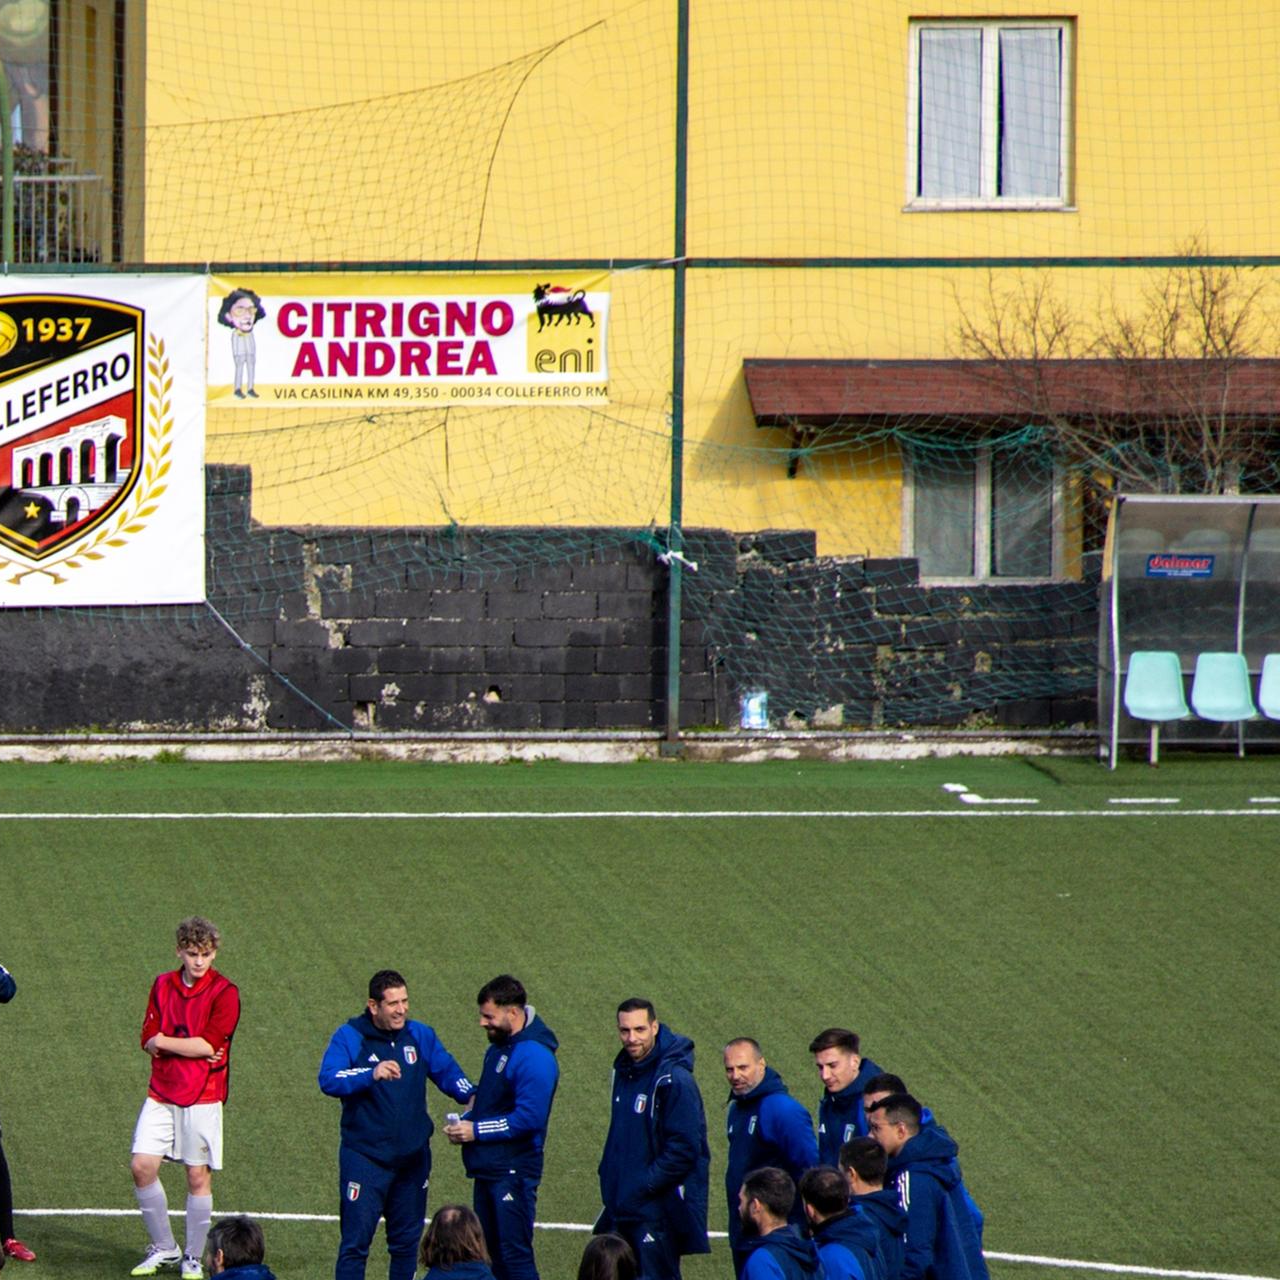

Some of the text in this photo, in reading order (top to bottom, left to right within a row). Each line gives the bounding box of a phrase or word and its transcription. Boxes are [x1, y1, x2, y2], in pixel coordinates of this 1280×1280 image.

[22, 317, 91, 343] 1937
[276, 300, 515, 338] CITRIGNO
[291, 341, 498, 377] ANDREA
[535, 338, 594, 374] eni
[274, 388, 298, 399] VIA
[301, 387, 364, 399] CASILINA
[368, 387, 389, 398] KM
[393, 387, 438, 399] 49,350
[450, 387, 491, 398] 00034
[495, 386, 580, 398] COLLEFERRO
[585, 387, 608, 397] RM
